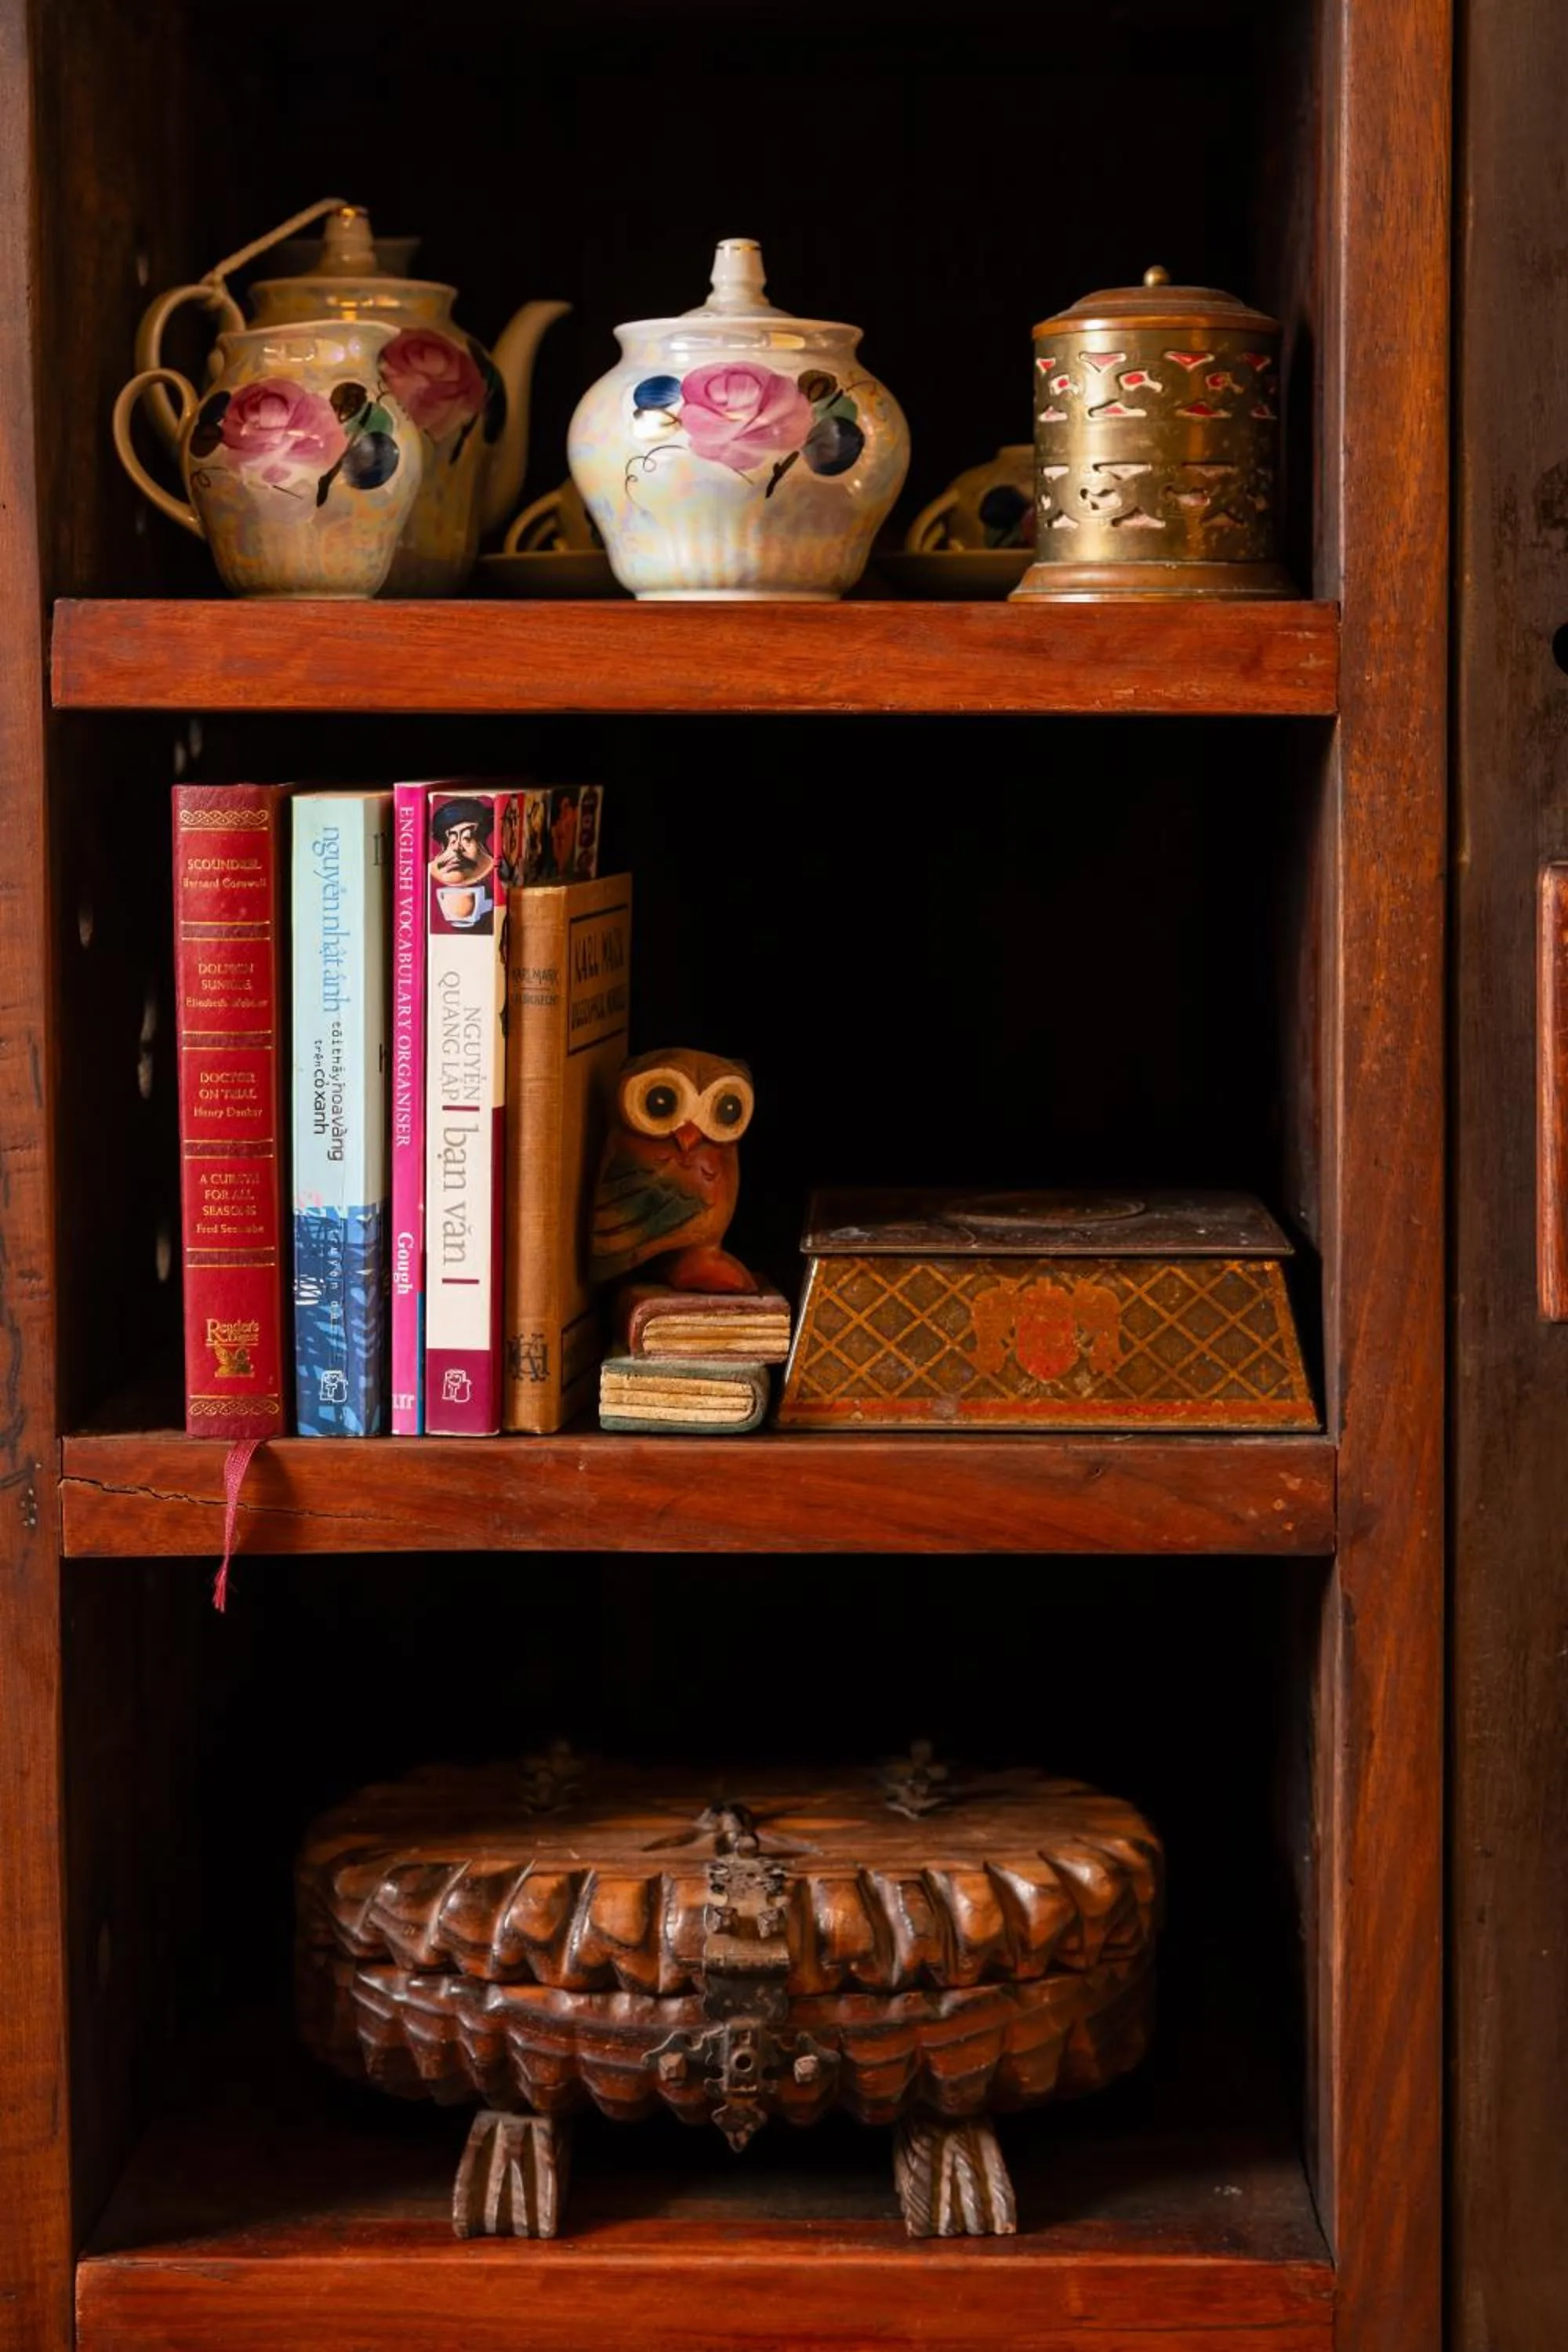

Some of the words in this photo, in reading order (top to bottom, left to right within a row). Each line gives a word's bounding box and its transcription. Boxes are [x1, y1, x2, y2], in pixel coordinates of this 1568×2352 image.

[398, 806, 414, 891] ENGLISH
[397, 896, 414, 1029] VOCABULARY
[438, 971, 461, 1054] QUANG
[199, 1089, 219, 1099] ON
[314, 1091, 329, 1134] xanh
[396, 1035, 412, 1148] ORGANISER
[200, 1174, 208, 1185] A
[437, 1124, 480, 1192] bạn
[205, 1189, 229, 1200] FOR
[394, 1232, 415, 1295] Gough
[442, 1201, 473, 1265] văn
